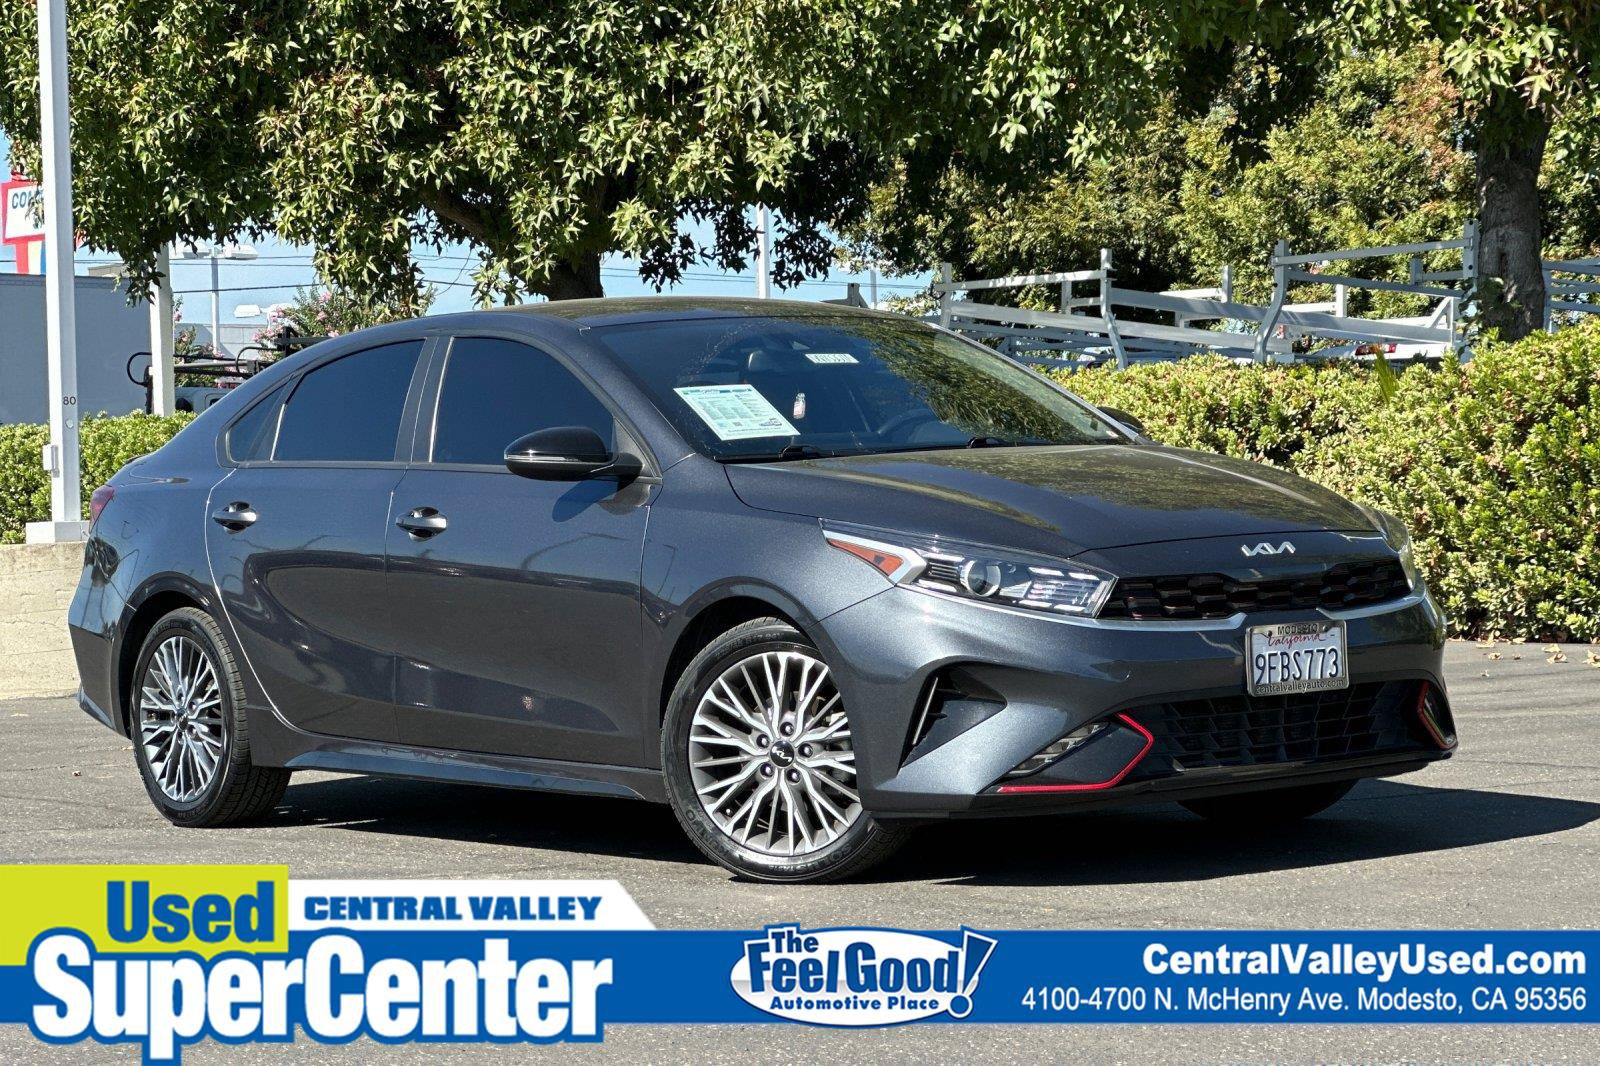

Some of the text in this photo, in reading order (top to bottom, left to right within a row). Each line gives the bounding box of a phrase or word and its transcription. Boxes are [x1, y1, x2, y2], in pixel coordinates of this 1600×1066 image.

[63, 396, 76, 405] 80
[1268, 634, 1326, 649] California
[1255, 646, 1339, 685] 9FBS773
